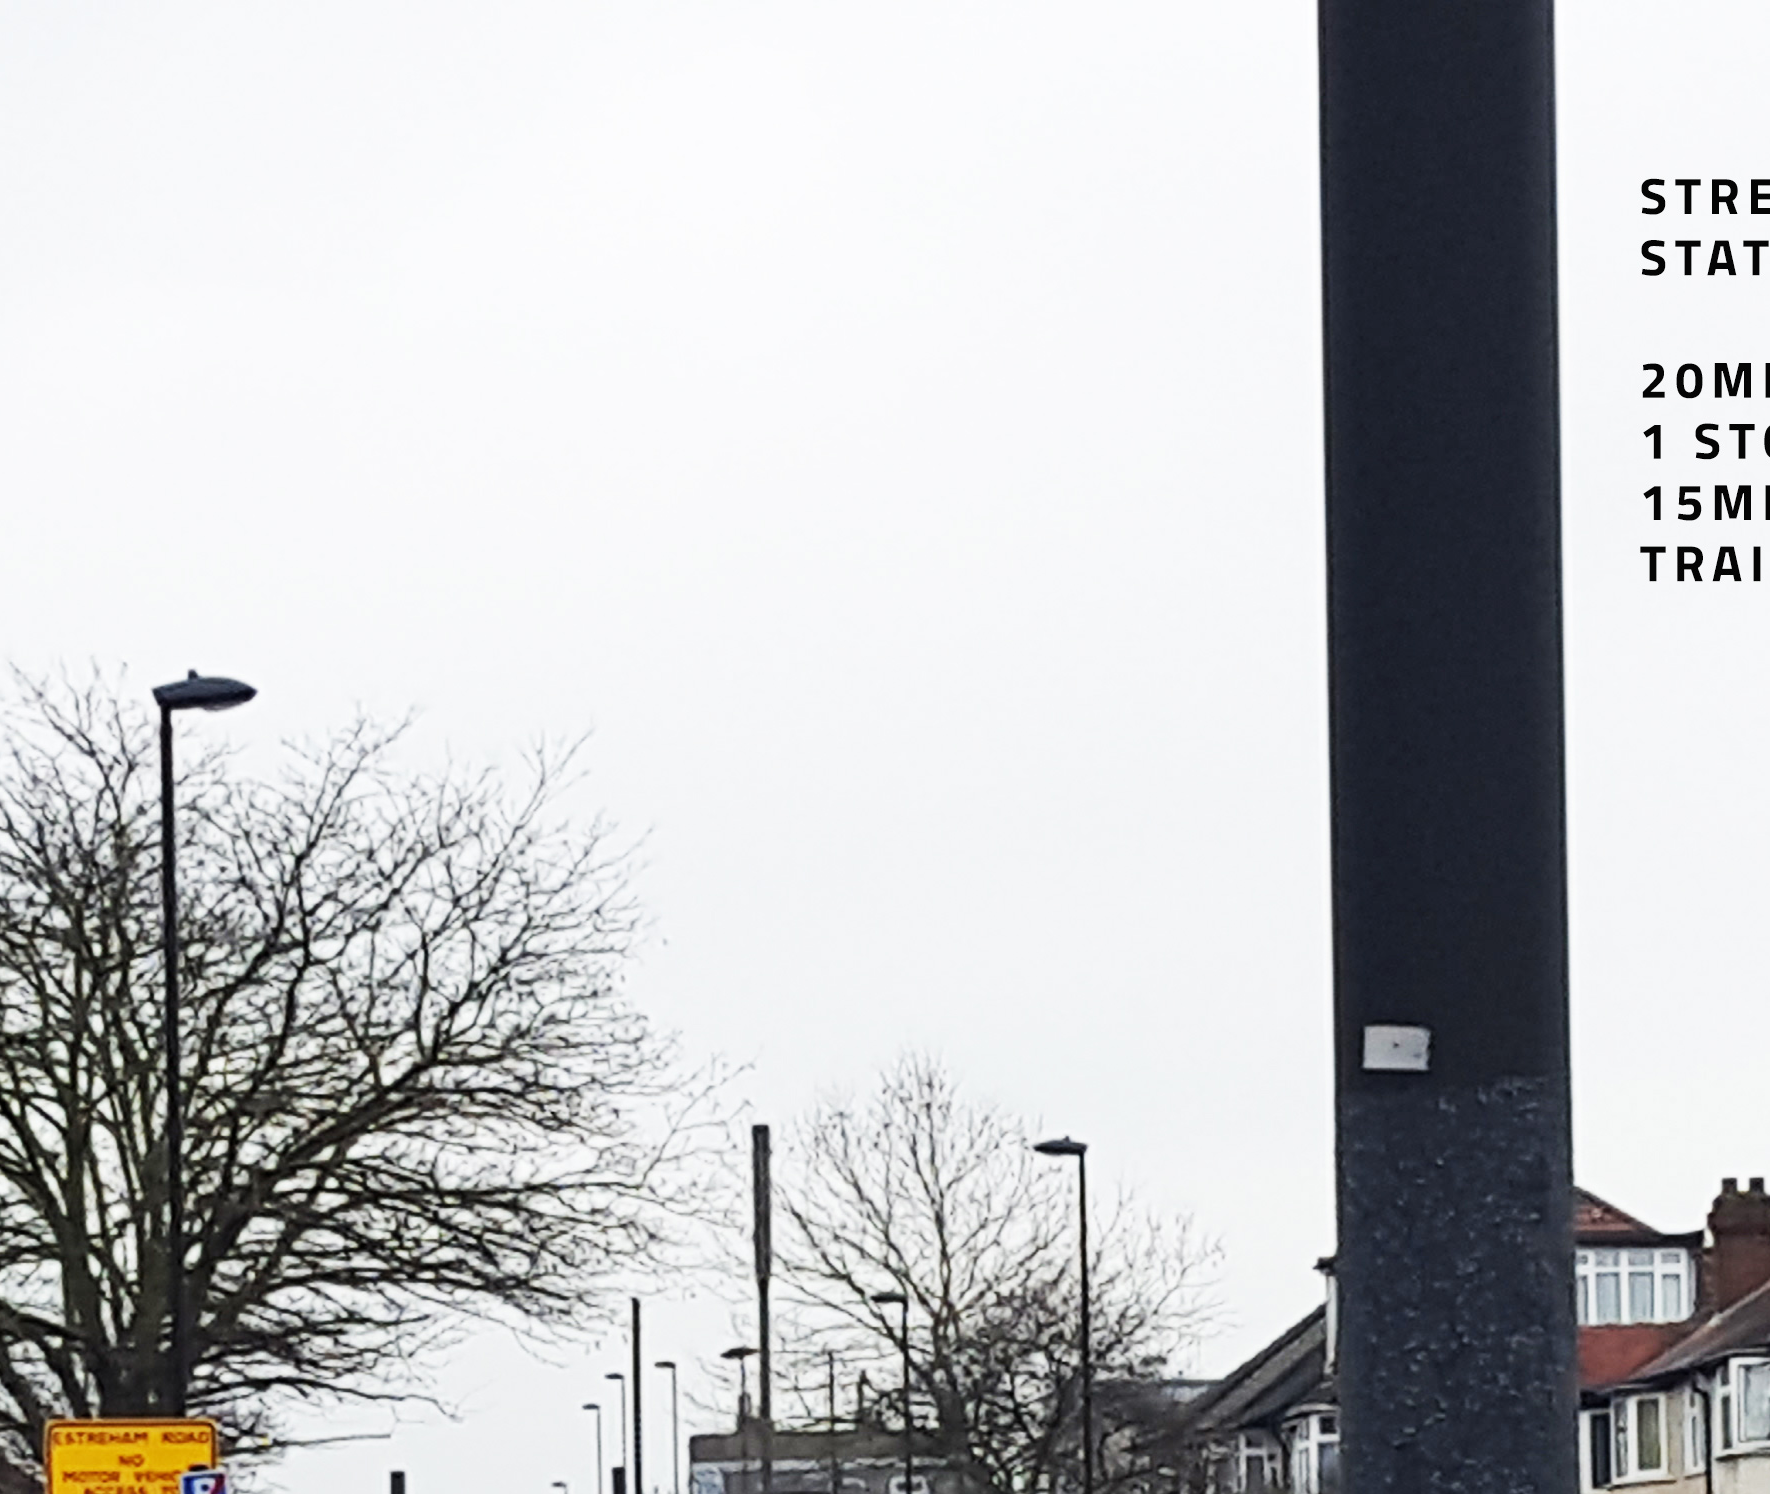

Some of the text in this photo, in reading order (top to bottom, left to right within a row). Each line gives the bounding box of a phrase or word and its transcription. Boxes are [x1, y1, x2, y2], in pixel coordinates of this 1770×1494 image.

[53, 1431, 209, 1445] ESTREHAM ROAD
[118, 1454, 145, 1467] NO
[62, 1471, 120, 1483] MOTOR
